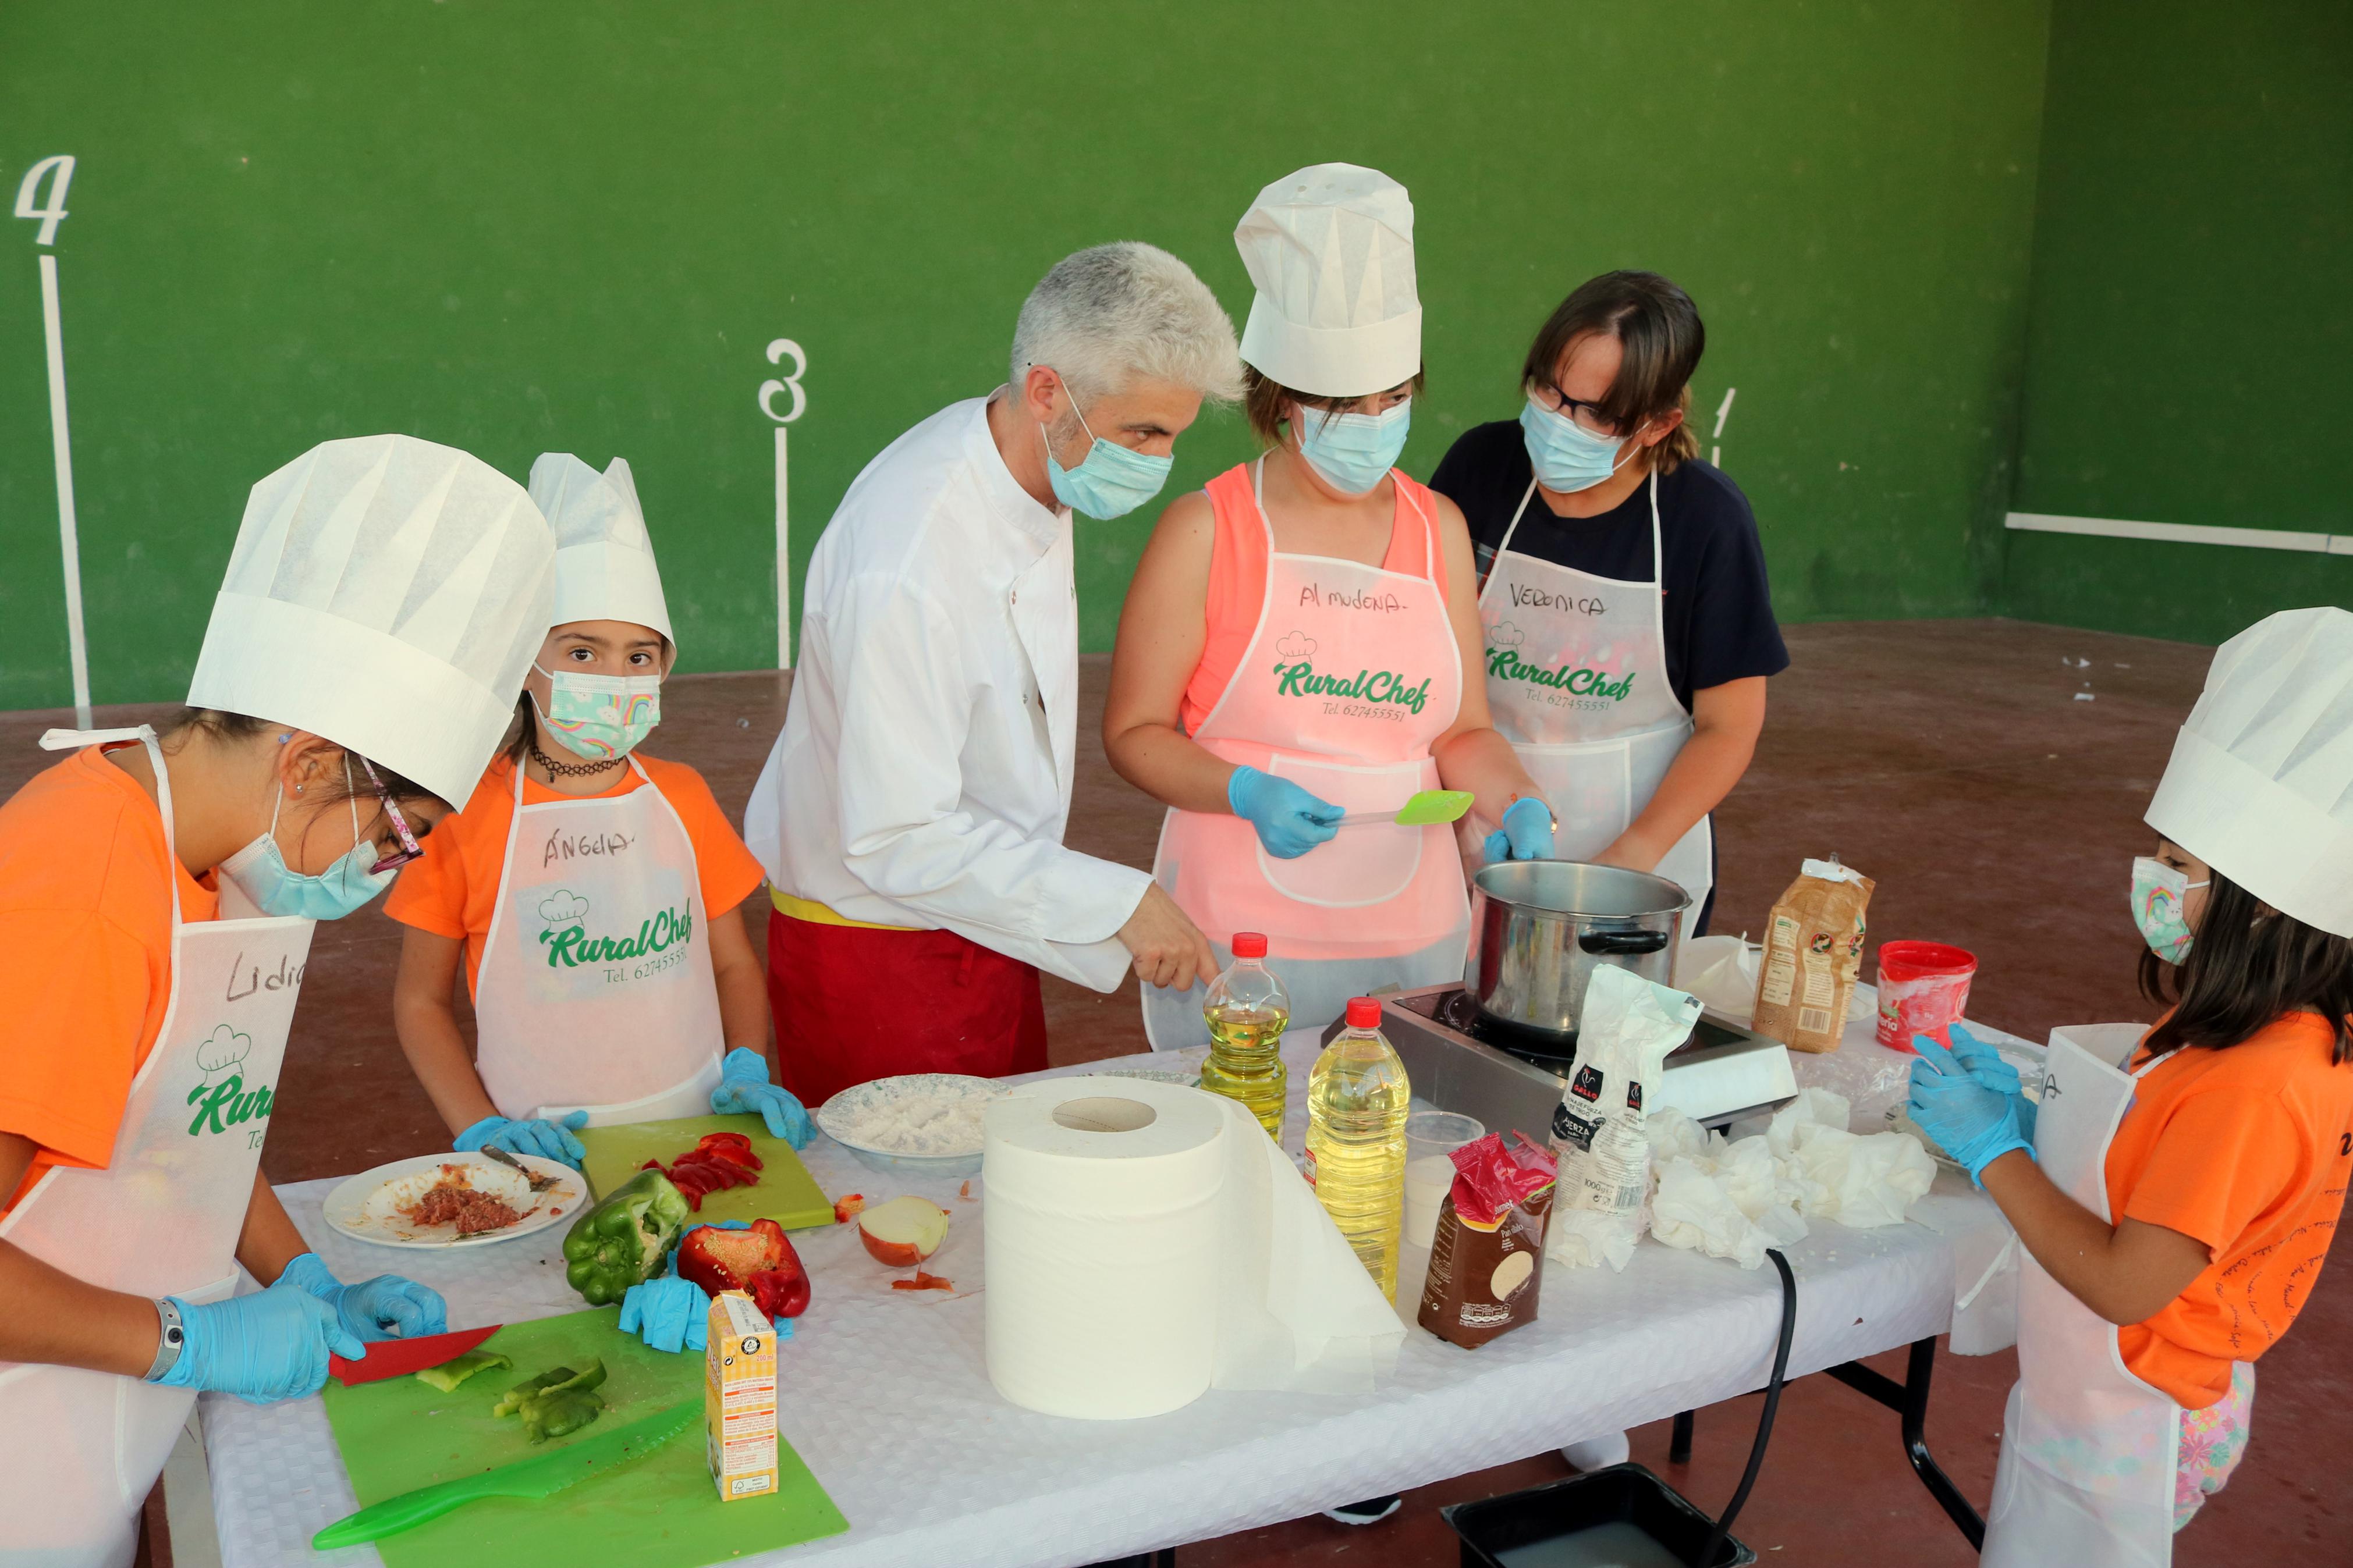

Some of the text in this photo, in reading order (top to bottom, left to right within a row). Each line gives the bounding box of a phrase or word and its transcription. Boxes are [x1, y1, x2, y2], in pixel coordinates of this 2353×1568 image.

[14, 155, 76, 246] 4
[758, 337, 807, 423] 3
[1713, 387, 1736, 438] 1
[1273, 661, 1432, 715] RuralChef
[1486, 647, 1636, 702] RuralChef
[1343, 705, 1406, 722] 627455551
[1547, 694, 1611, 711] 627455551
[539, 897, 692, 968] RuralChef
[1573, 1084, 1598, 1099] GALLO
[1500, 1229, 1512, 1239] Pan
